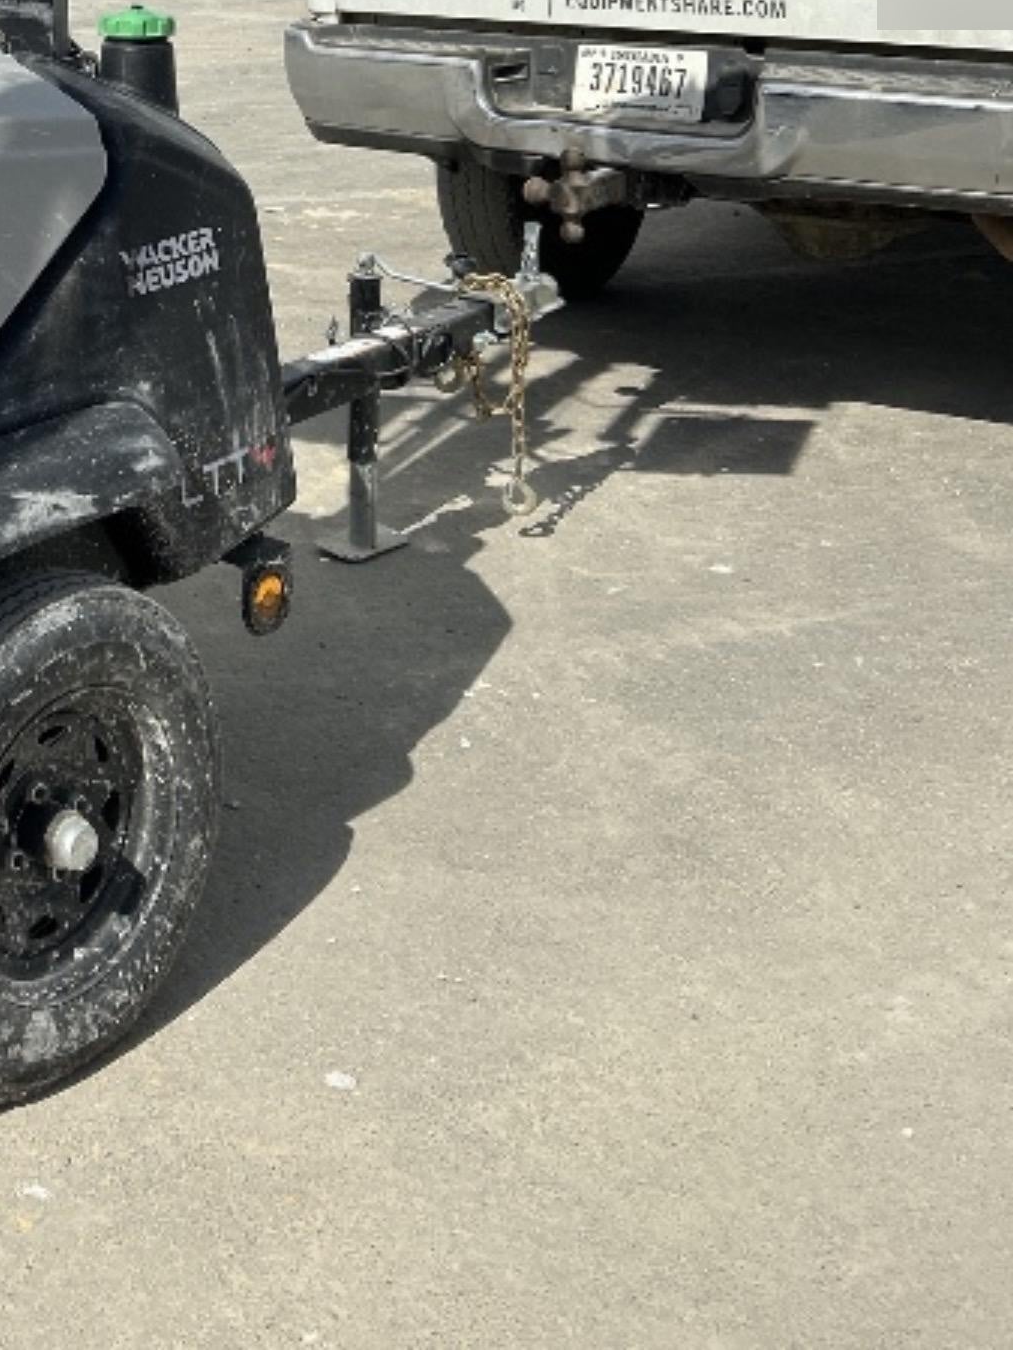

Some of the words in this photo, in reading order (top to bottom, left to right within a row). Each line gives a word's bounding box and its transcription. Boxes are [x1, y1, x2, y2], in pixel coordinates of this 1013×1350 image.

[589, 62, 688, 99] 3719467
[118, 227, 216, 268] WACKER
[128, 248, 220, 297] NEUSON
